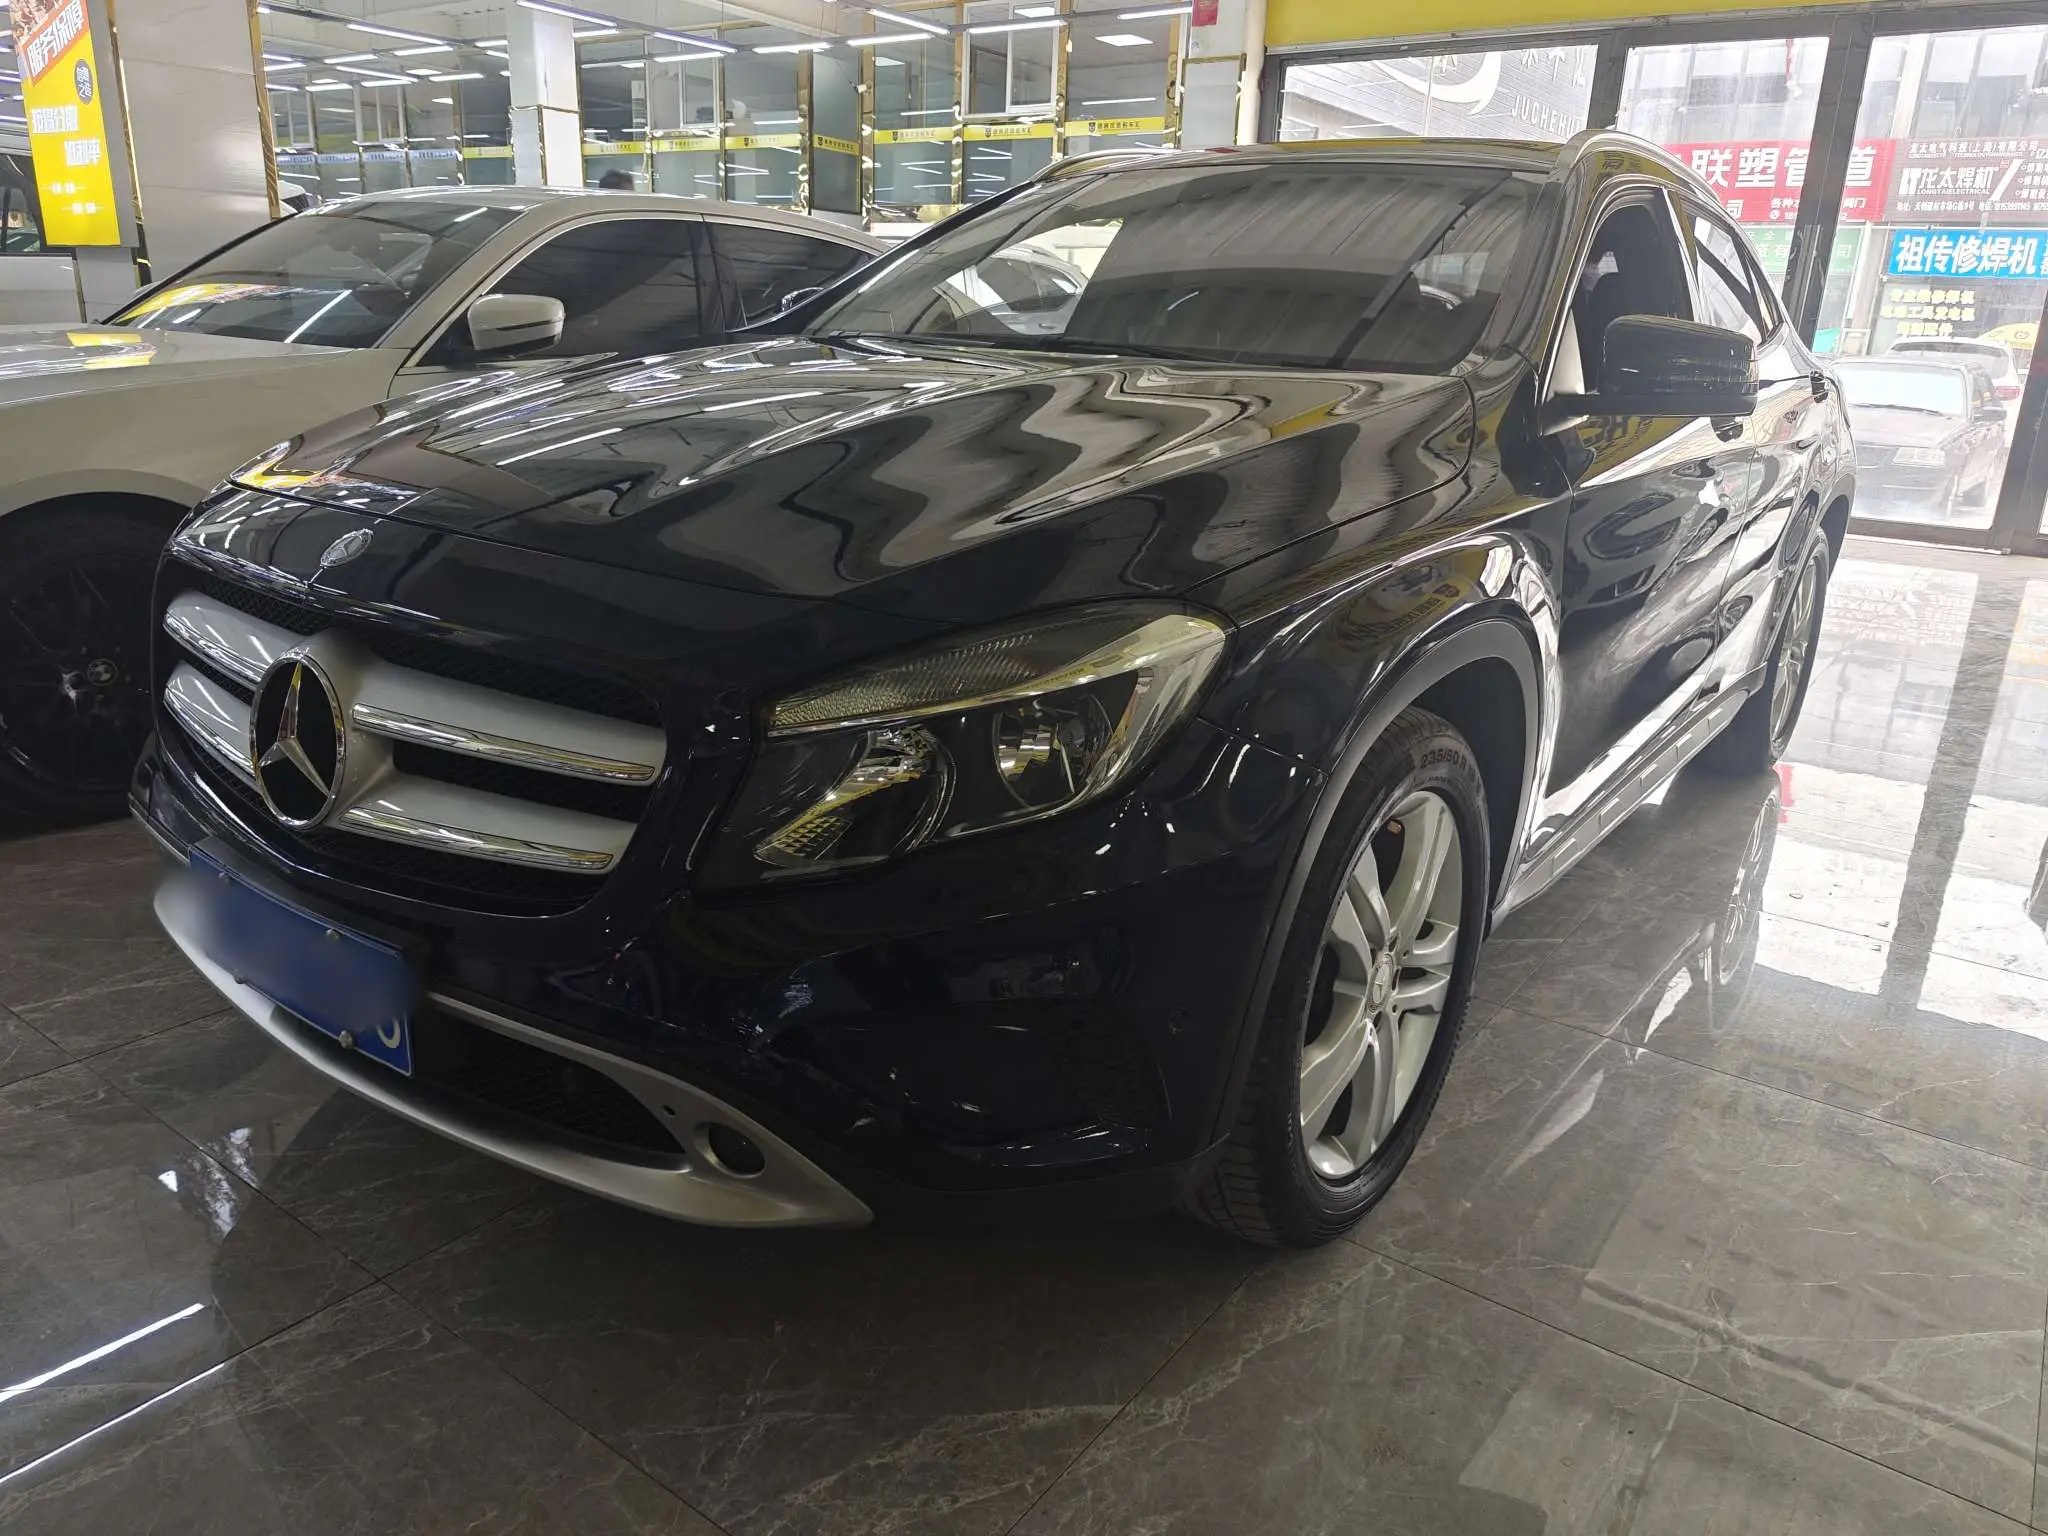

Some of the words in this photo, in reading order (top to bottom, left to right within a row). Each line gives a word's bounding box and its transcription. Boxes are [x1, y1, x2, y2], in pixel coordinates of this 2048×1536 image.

[1896, 235, 2039, 274] 祖传修焊机
